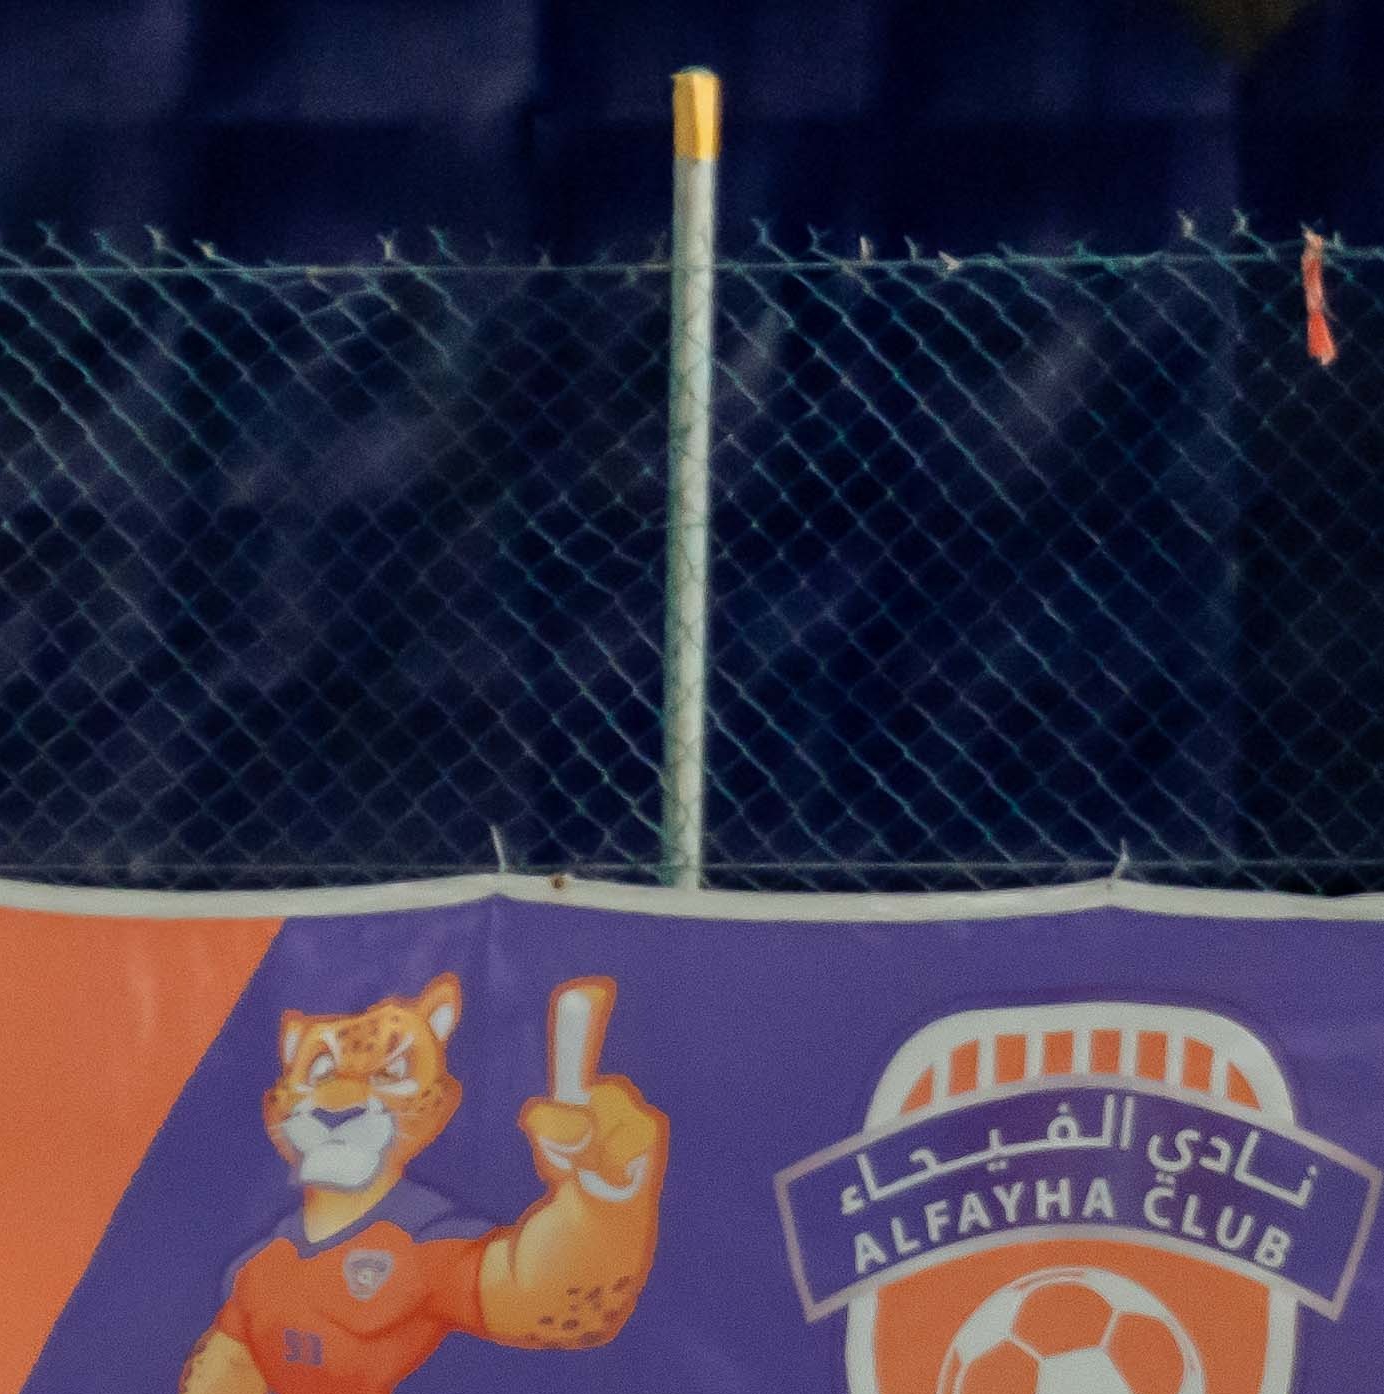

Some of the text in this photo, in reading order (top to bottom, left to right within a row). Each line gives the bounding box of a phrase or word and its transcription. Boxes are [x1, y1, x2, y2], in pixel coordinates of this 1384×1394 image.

[840, 1093, 1319, 1216] نادي الفيحاء
[854, 1177, 1292, 1273] ALFAYHA CLUB
